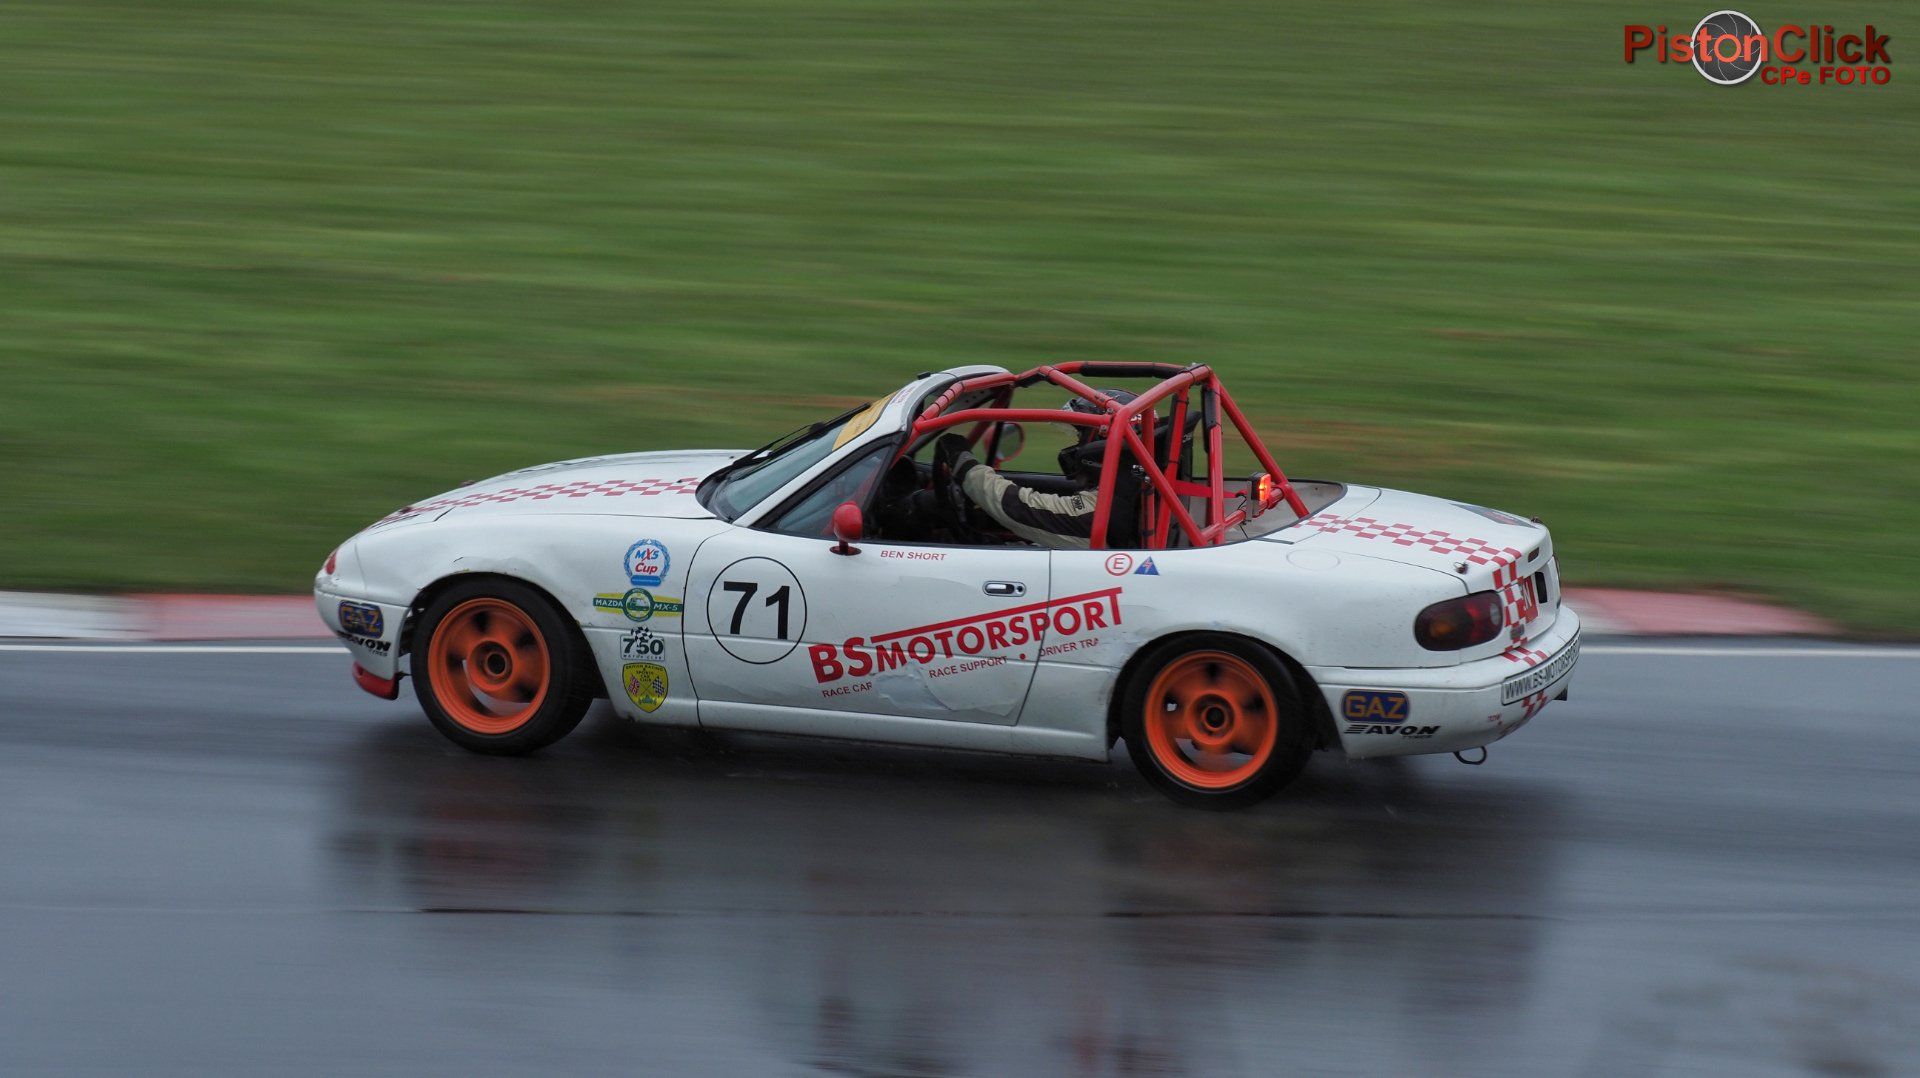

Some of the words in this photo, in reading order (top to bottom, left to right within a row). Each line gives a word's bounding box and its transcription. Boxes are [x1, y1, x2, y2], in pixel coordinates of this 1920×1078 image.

[880, 550, 905, 559] BEN
[907, 551, 947, 561] SHORT
[634, 562, 659, 575] Cup
[1113, 557, 1125, 569] E
[595, 599, 624, 608] MAZDA
[653, 603, 678, 611] MX-5
[722, 581, 791, 640] 71
[622, 637, 664, 656] 750
[822, 686, 851, 698] RACE
[929, 665, 958, 678] RACE
[960, 656, 1009, 673] SUPPORT
[1039, 642, 1078, 657] DRIVER
[1345, 694, 1406, 720] GAZ
[1366, 725, 1441, 735] AVON
